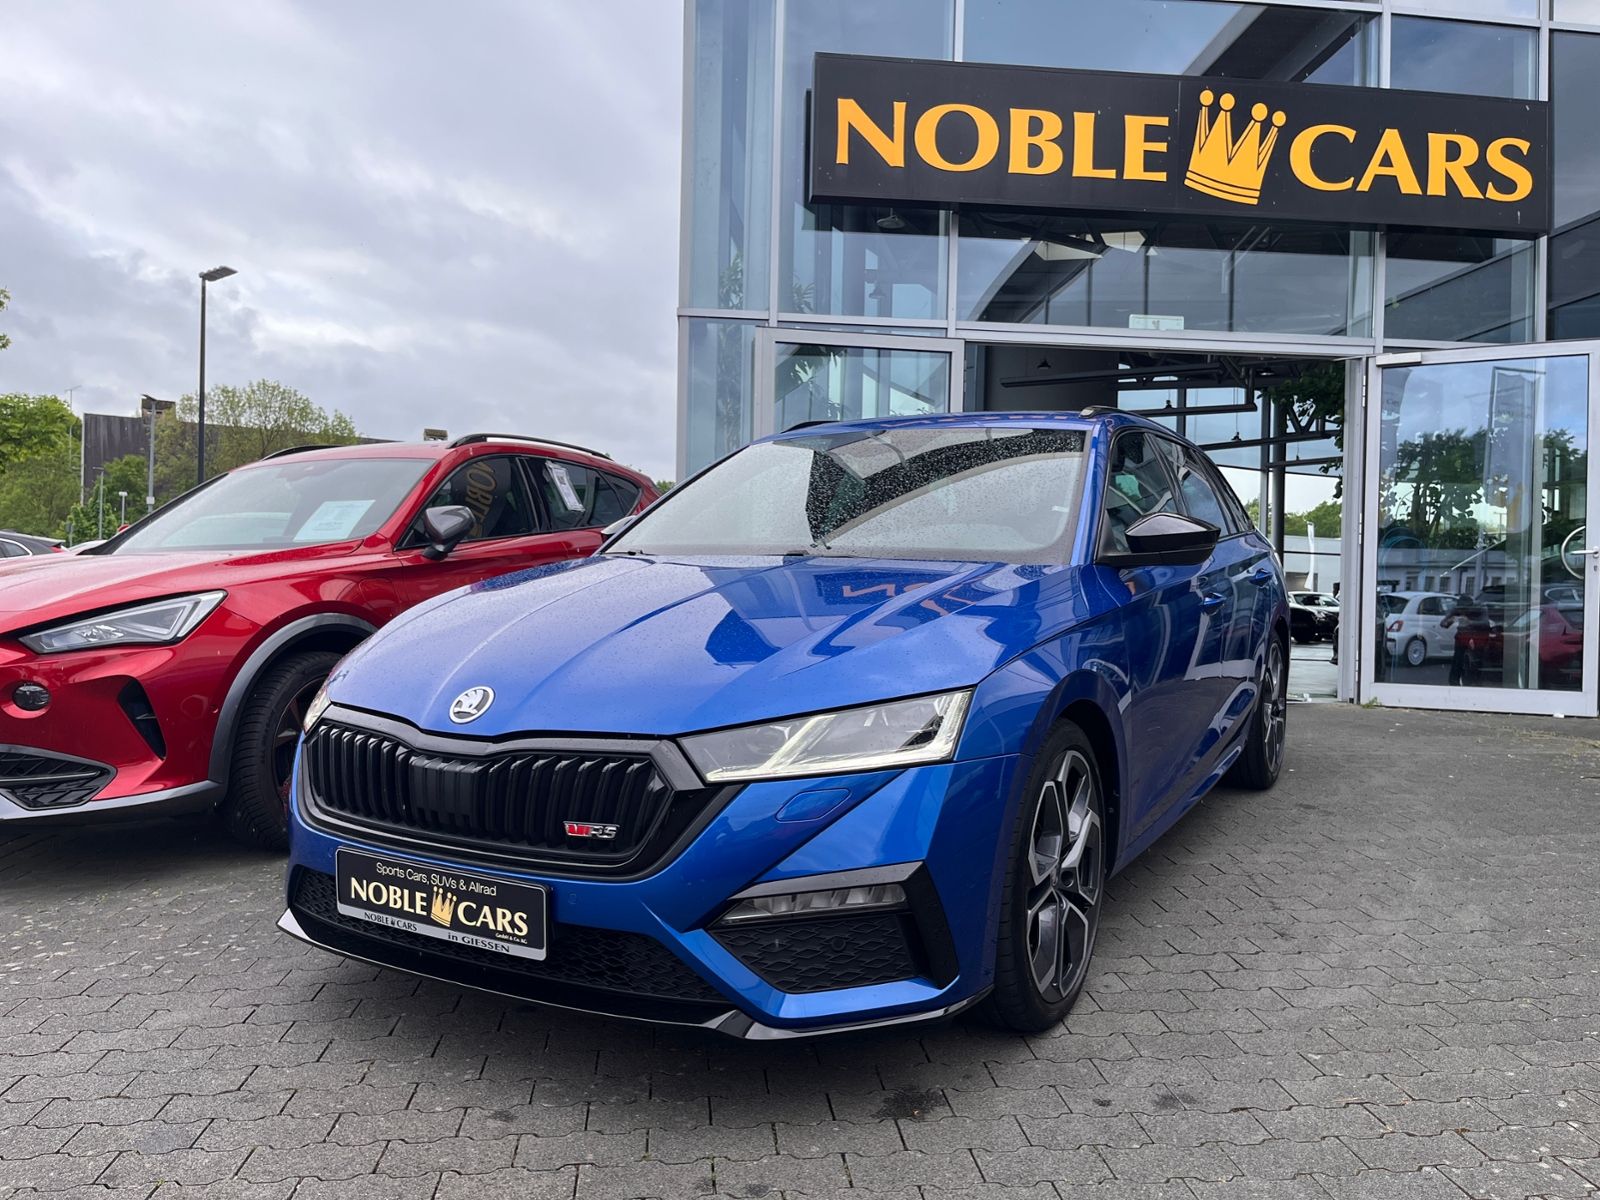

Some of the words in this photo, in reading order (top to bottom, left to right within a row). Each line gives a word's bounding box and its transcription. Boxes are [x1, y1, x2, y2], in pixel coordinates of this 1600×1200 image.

[836, 98, 1169, 181] NOBLE
[1290, 124, 1534, 202] CARS
[376, 862, 405, 878] Sports
[406, 869, 429, 885] Cars,
[430, 873, 457, 889] SUVs
[458, 879, 467, 891] &
[468, 881, 497, 896] Allrad
[350, 876, 428, 916] NOBLE
[457, 901, 528, 936] CARS
[364, 912, 389, 925] NOBLE
[396, 919, 418, 932] CARS
[448, 932, 458, 941] in
[461, 935, 510, 953] GIESSEN
